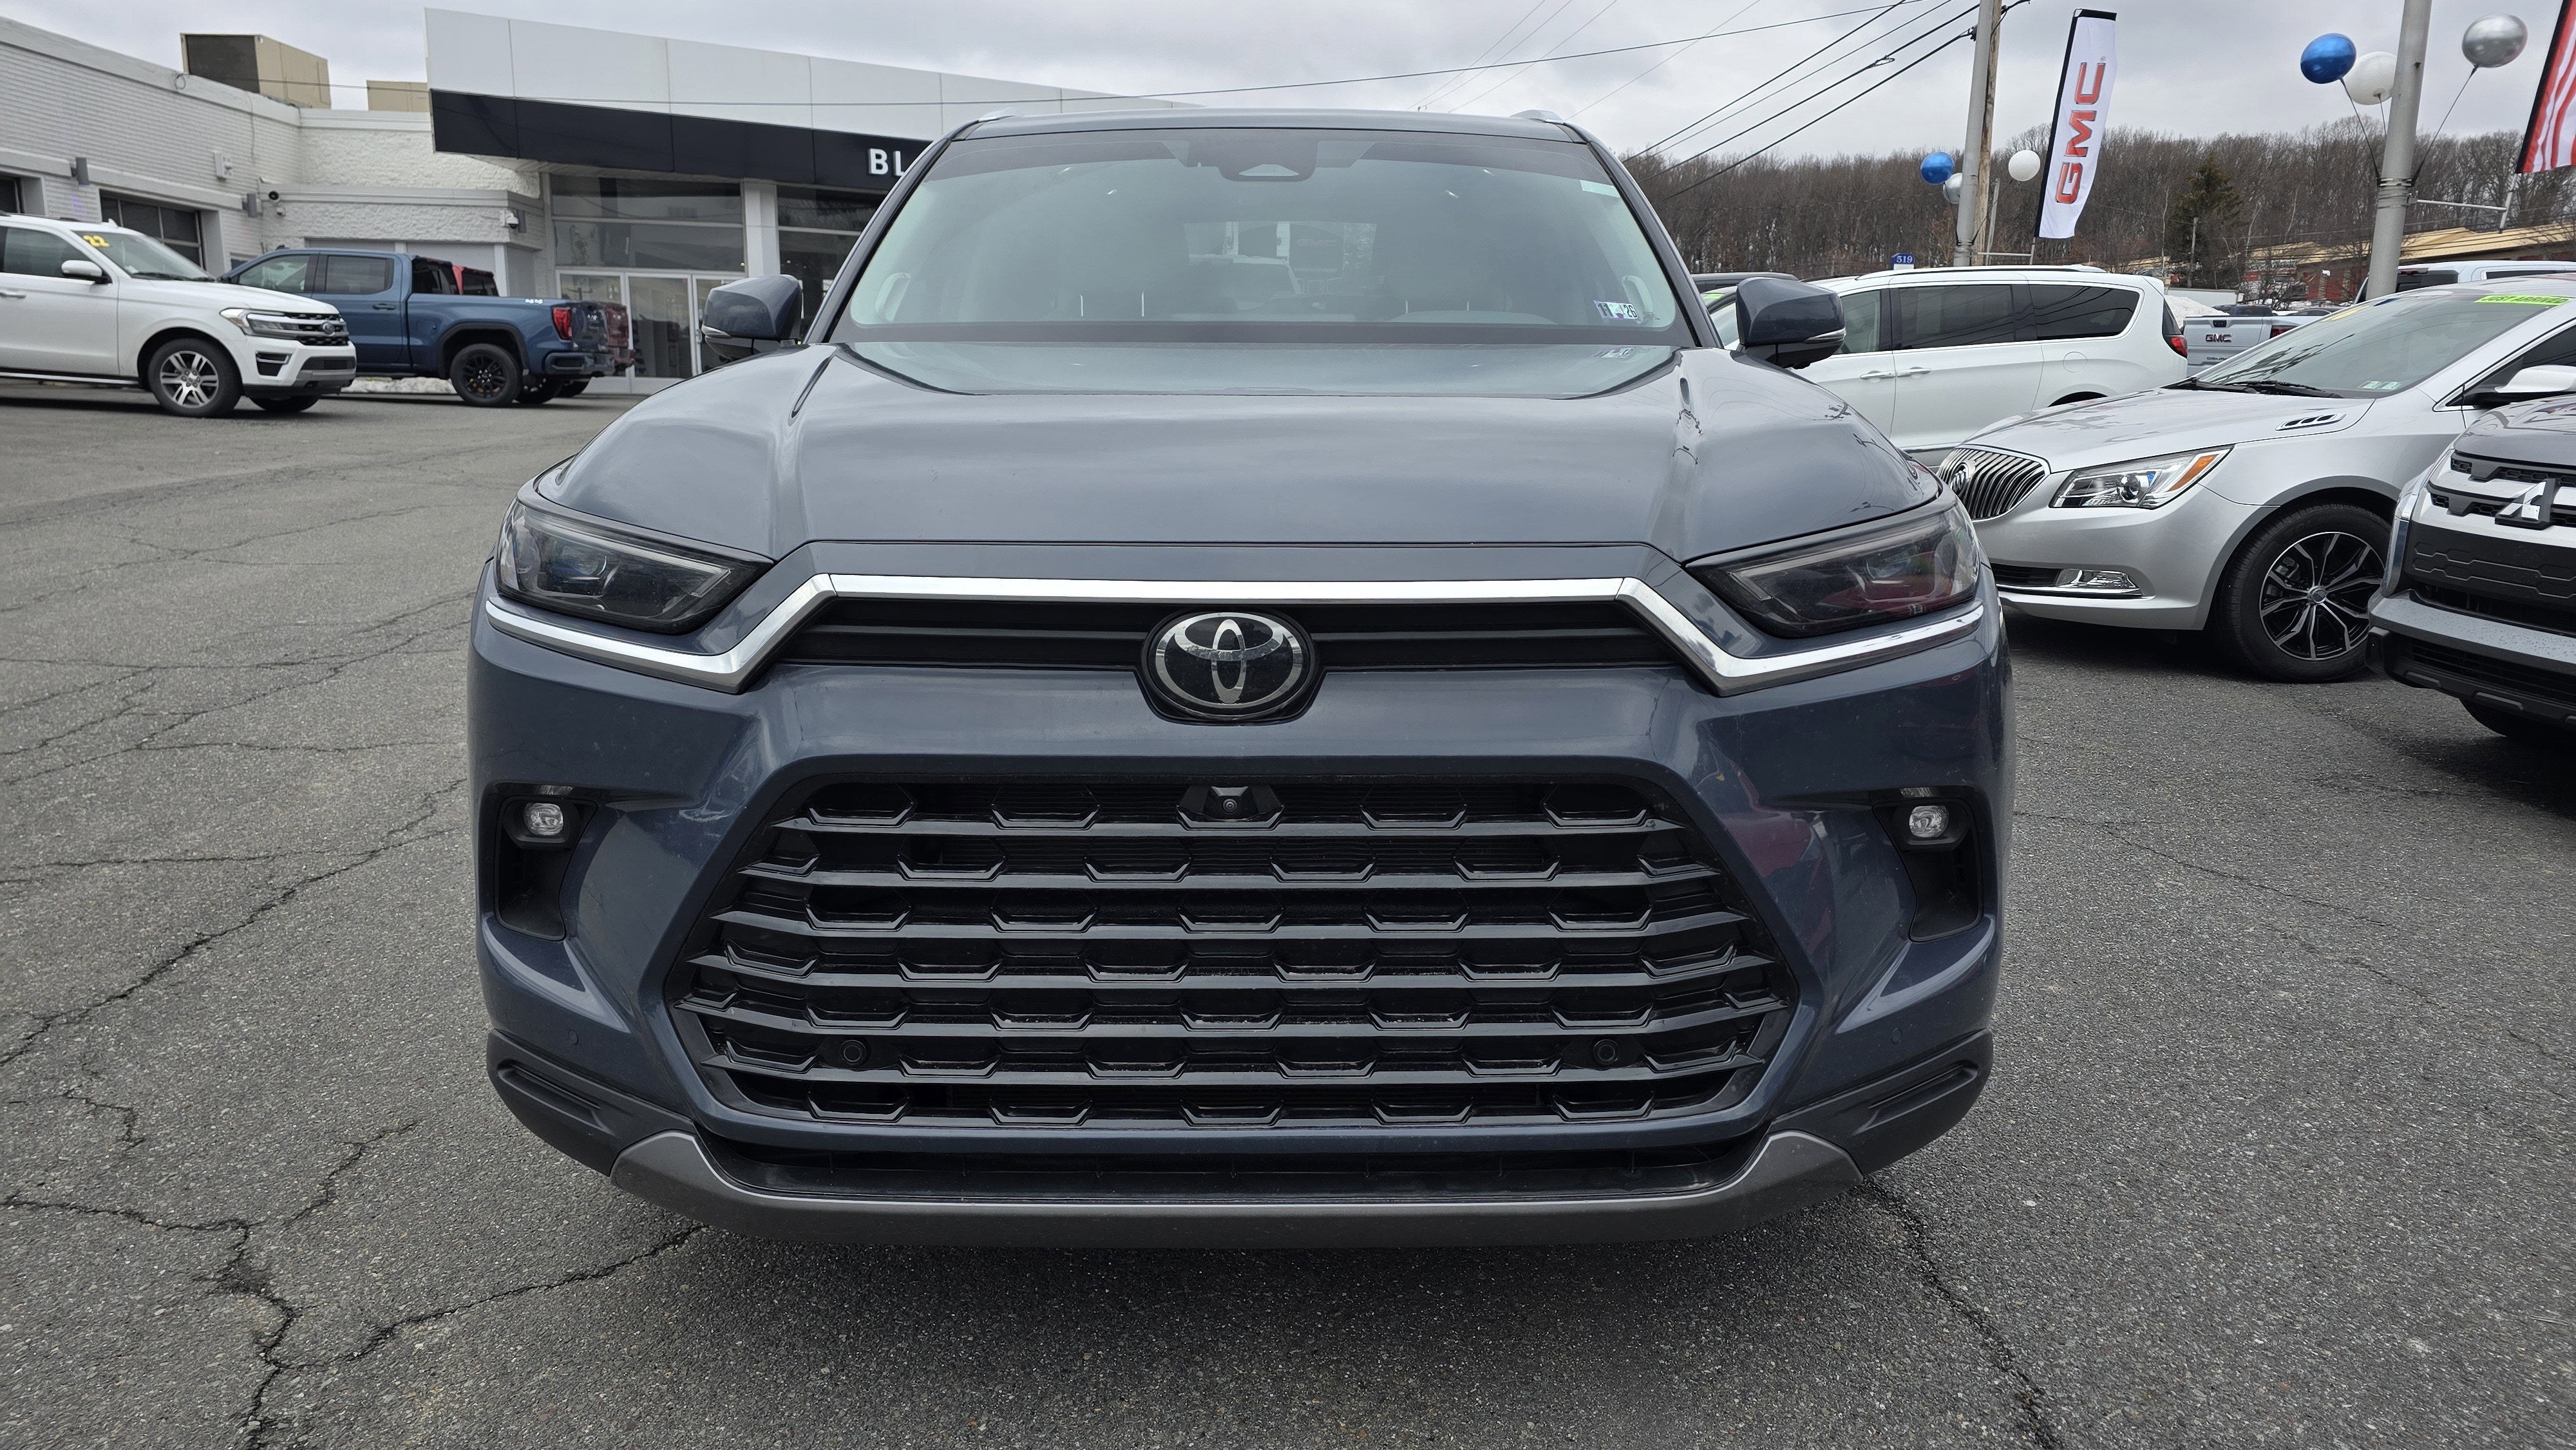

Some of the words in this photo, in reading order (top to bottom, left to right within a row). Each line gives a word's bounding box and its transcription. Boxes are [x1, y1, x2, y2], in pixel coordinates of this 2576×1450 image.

[2055, 62, 2106, 204] GMC
[1895, 255, 1913, 263] 519
[2205, 334, 2232, 343] GMC
